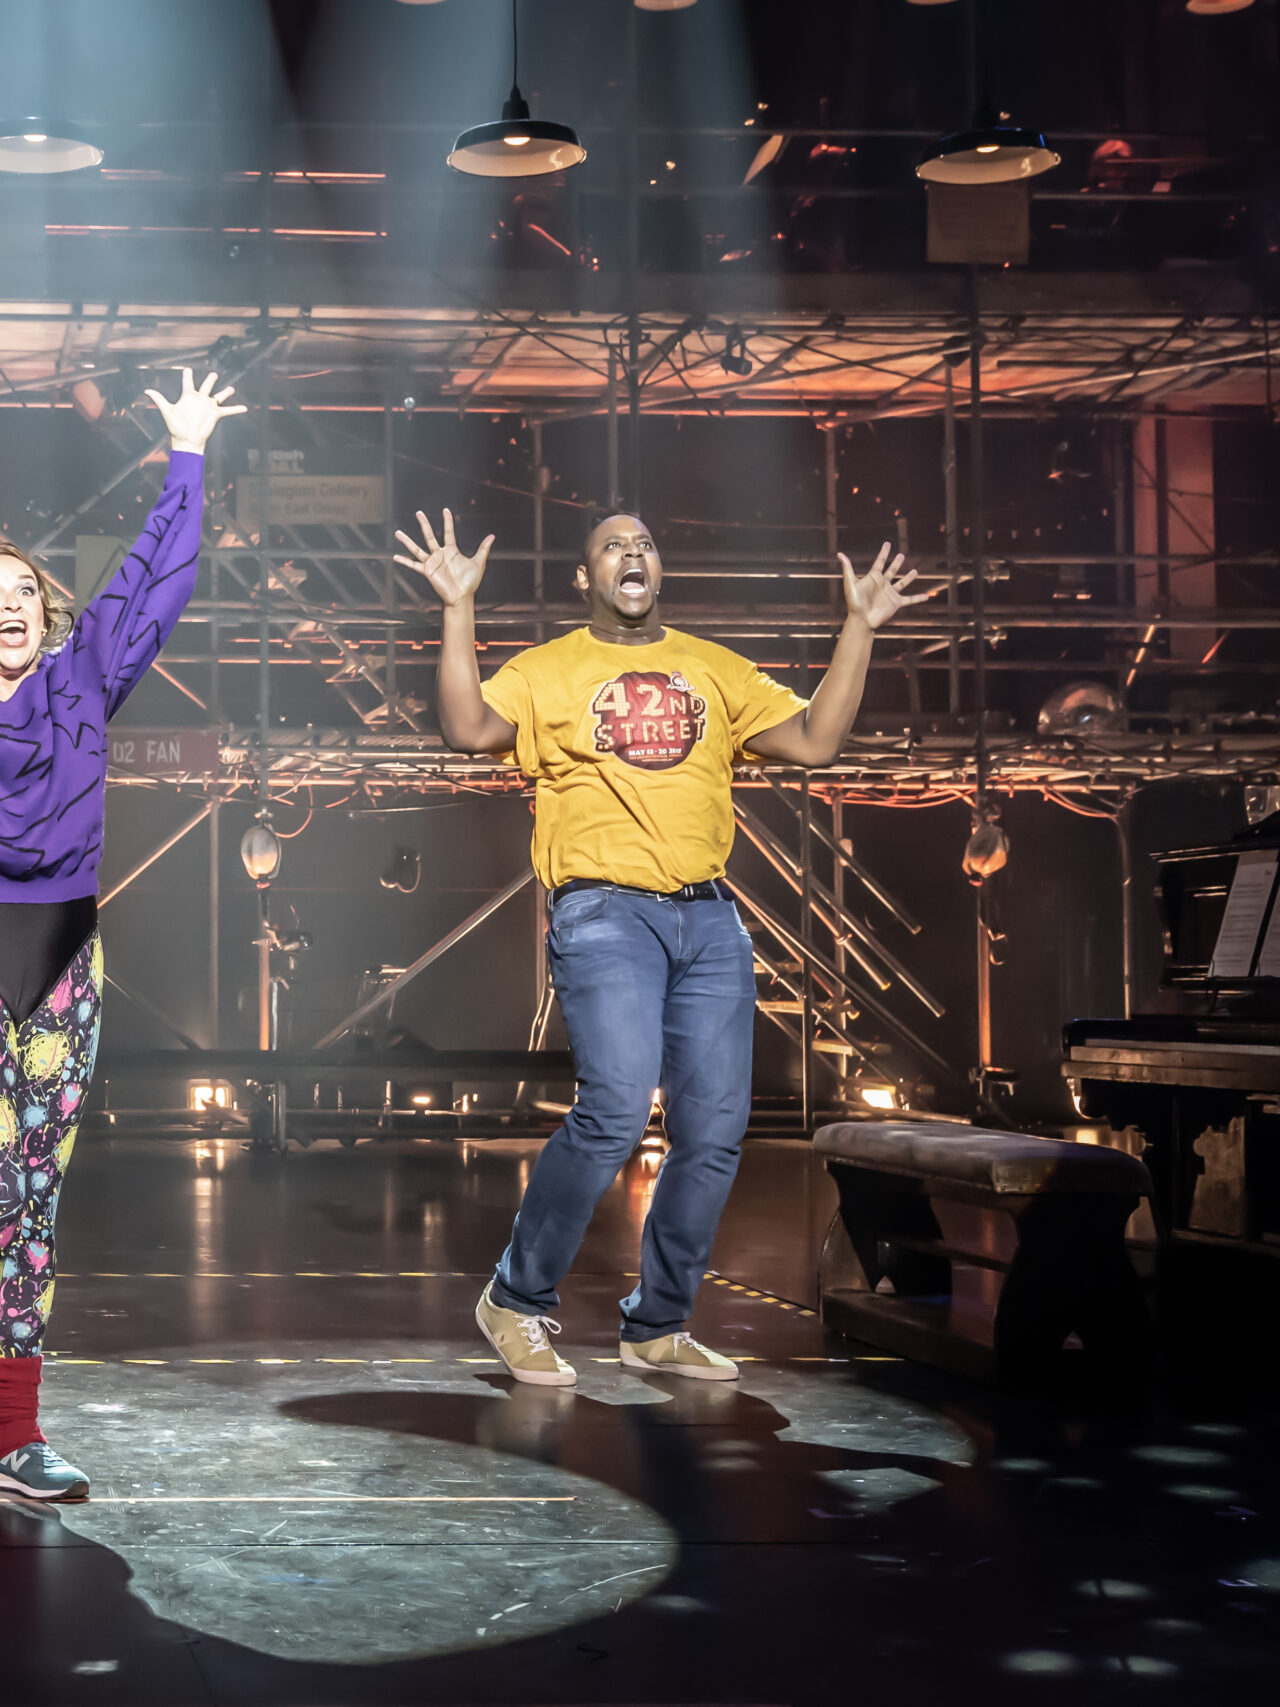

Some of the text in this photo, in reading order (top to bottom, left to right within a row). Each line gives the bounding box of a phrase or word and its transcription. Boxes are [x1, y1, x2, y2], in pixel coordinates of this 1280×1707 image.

[593, 682, 705, 718] 42ND
[595, 718, 705, 750] STREET
[146, 740, 180, 763] FAN
